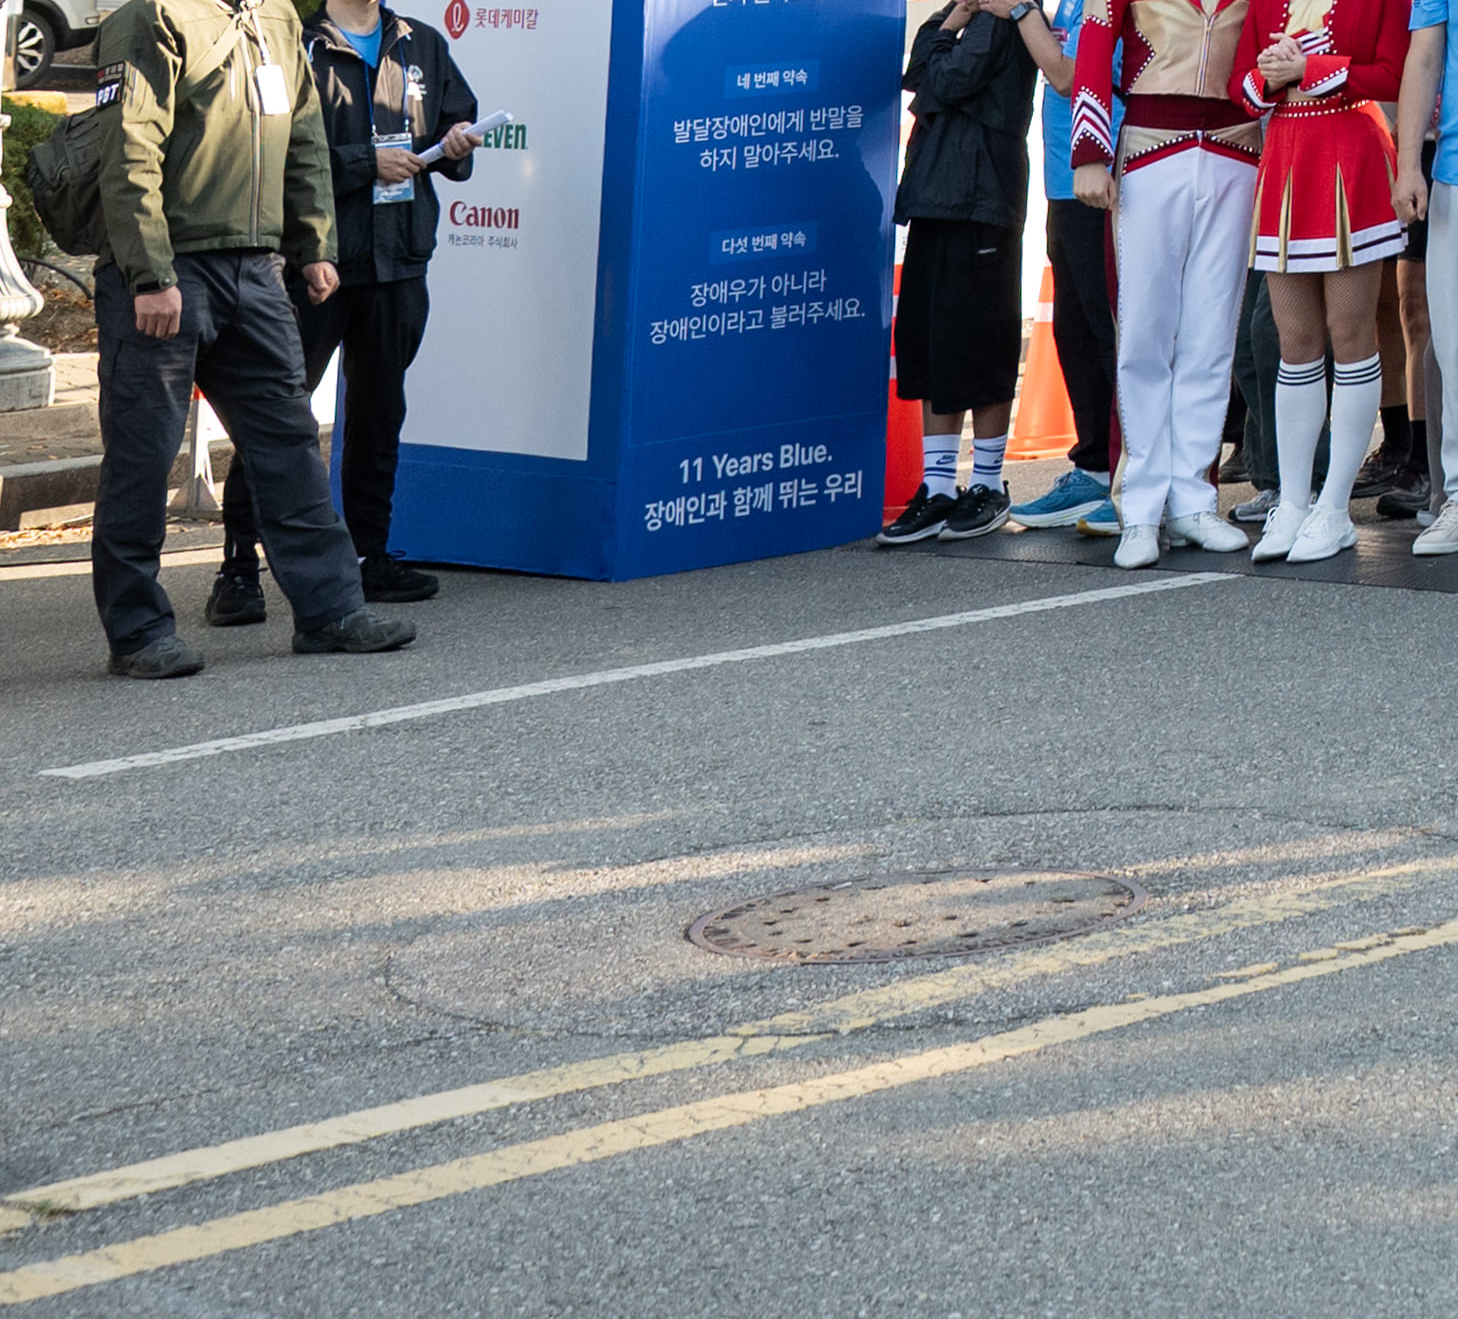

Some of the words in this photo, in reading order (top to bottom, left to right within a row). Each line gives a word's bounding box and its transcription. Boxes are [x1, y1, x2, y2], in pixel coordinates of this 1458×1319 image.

[474, 7, 539, 30] 롯데케미칼
[737, 69, 749, 89] 네
[752, 69, 779, 89] 번째
[783, 68, 808, 87] 약속
[674, 110, 804, 143] 발달장애인에게
[809, 104, 864, 131] 반말을
[700, 143, 735, 170] 하지
[743, 138, 839, 167] 말아주세요.
[449, 201, 519, 229] Canon
[722, 236, 746, 255] 다섯
[752, 233, 776, 252] 번째
[780, 230, 806, 249] 약속
[690, 278, 765, 306] 장애우가
[771, 270, 827, 297] 아니라
[650, 309, 764, 345] 장애인이라고
[770, 298, 866, 330] 불러주세요.
[679, 459, 703, 483] 11
[712, 451, 774, 479] Years
[780, 441, 833, 465] Blue.
[644, 494, 727, 531] 장애인과
[733, 483, 773, 513] 함께
[778, 479, 819, 508] 뛰는
[824, 470, 863, 500] 우리
